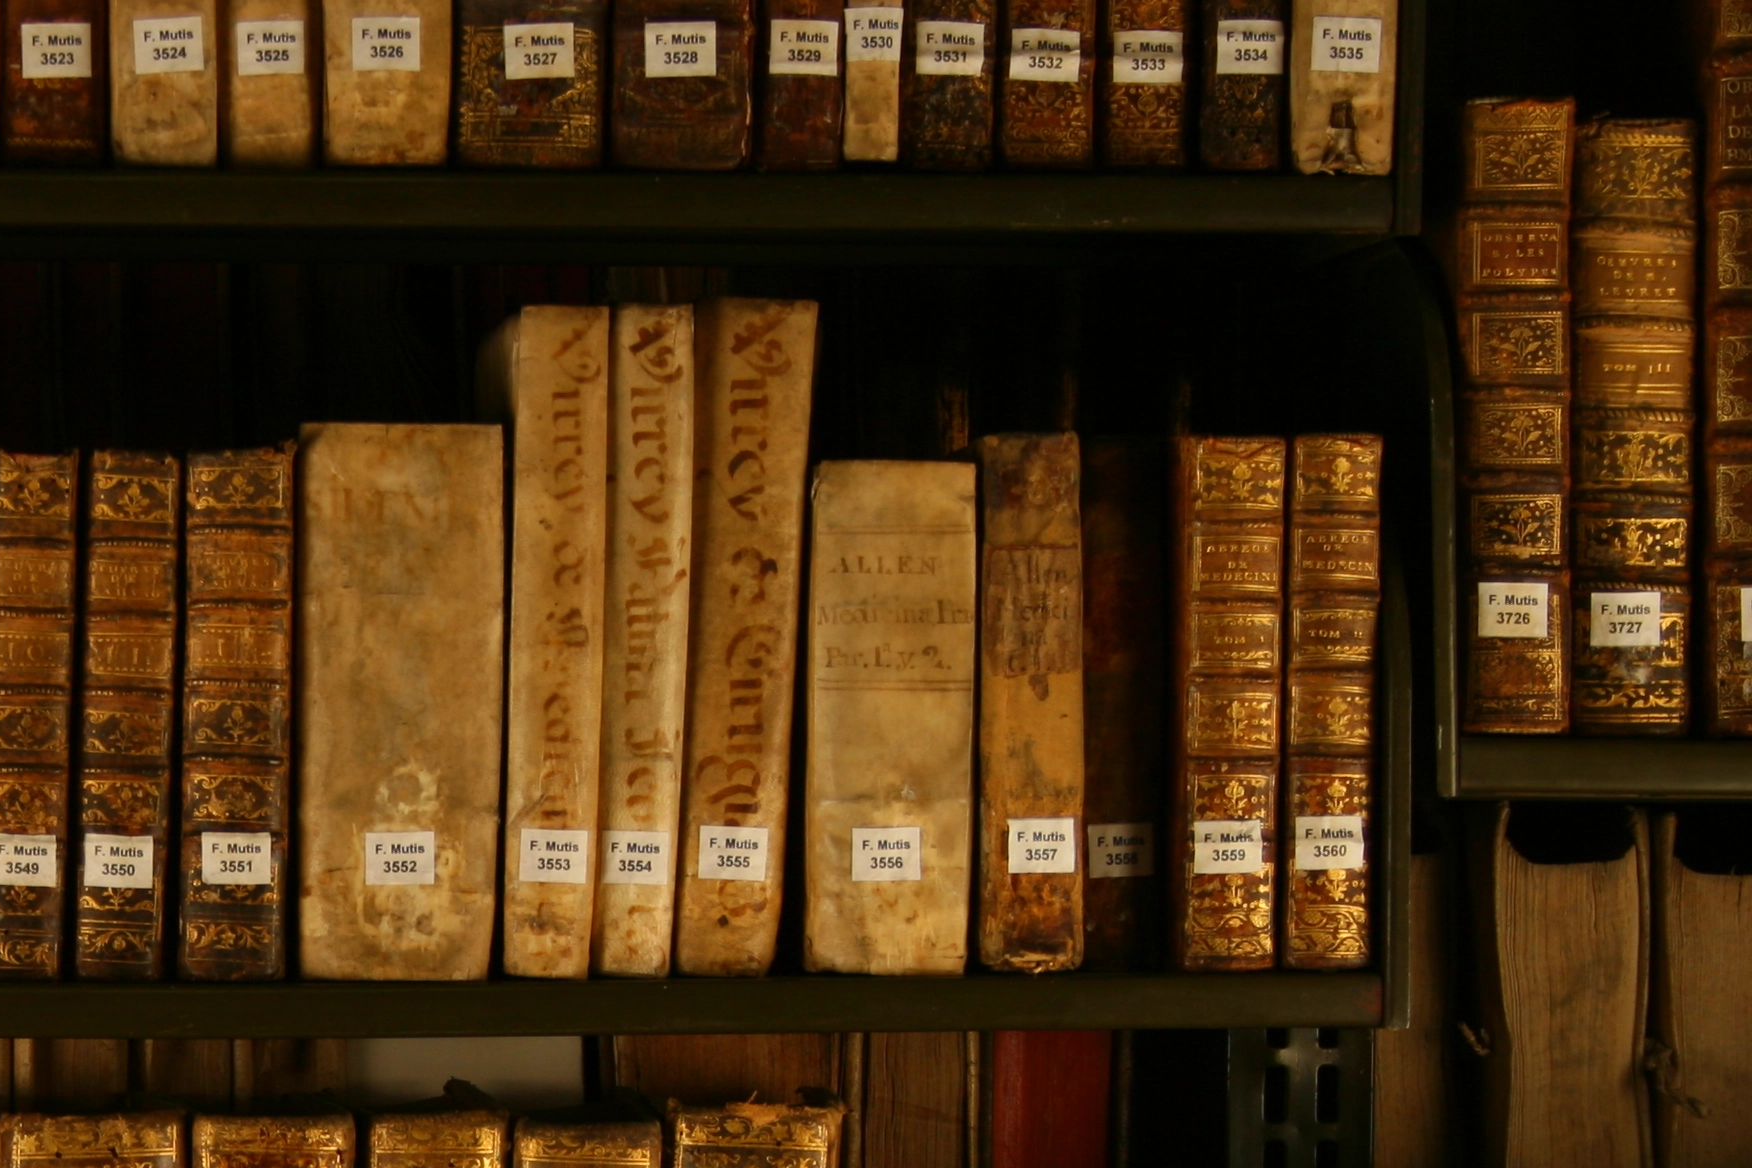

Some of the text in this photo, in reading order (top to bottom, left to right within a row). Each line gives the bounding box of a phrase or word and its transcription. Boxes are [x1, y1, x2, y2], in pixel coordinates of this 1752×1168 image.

[143, 28, 194, 43] F. Mutis
[655, 32, 707, 46] F. Mutis
[860, 35, 894, 49] 3530
[40, 52, 75, 66] 3523
[152, 46, 188, 61] 3524
[255, 48, 290, 63] 3525
[370, 44, 404, 59] 3526
[663, 50, 699, 65] 3528
[787, 48, 822, 63] 3529
[934, 49, 968, 63] 3531
[1234, 48, 1269, 63] 3534
[1329, 45, 1364, 60] 3535
[523, 52, 558, 67] 3527
[1028, 55, 1064, 70] 3532
[1131, 57, 1166, 72] 3533
[1602, 363, 1638, 373] TOM
[1600, 603, 1651, 616] F. Mutis
[1496, 611, 1531, 626] 3726
[1307, 628, 1341, 639] TOM
[1608, 620, 1644, 634] 3727
[374, 842, 426, 855] F. Mutis
[1025, 848, 1058, 862] 3557
[1212, 848, 1246, 862] 3559
[1313, 844, 1348, 858] 3560
[5, 861, 40, 876] 3549
[219, 859, 253, 874] 3551
[382, 860, 418, 874] 3552
[536, 857, 571, 872] 3553
[618, 858, 653, 873] 3554
[716, 854, 751, 869] 3555
[870, 856, 904, 870] 3556
[101, 862, 136, 877] 3550
